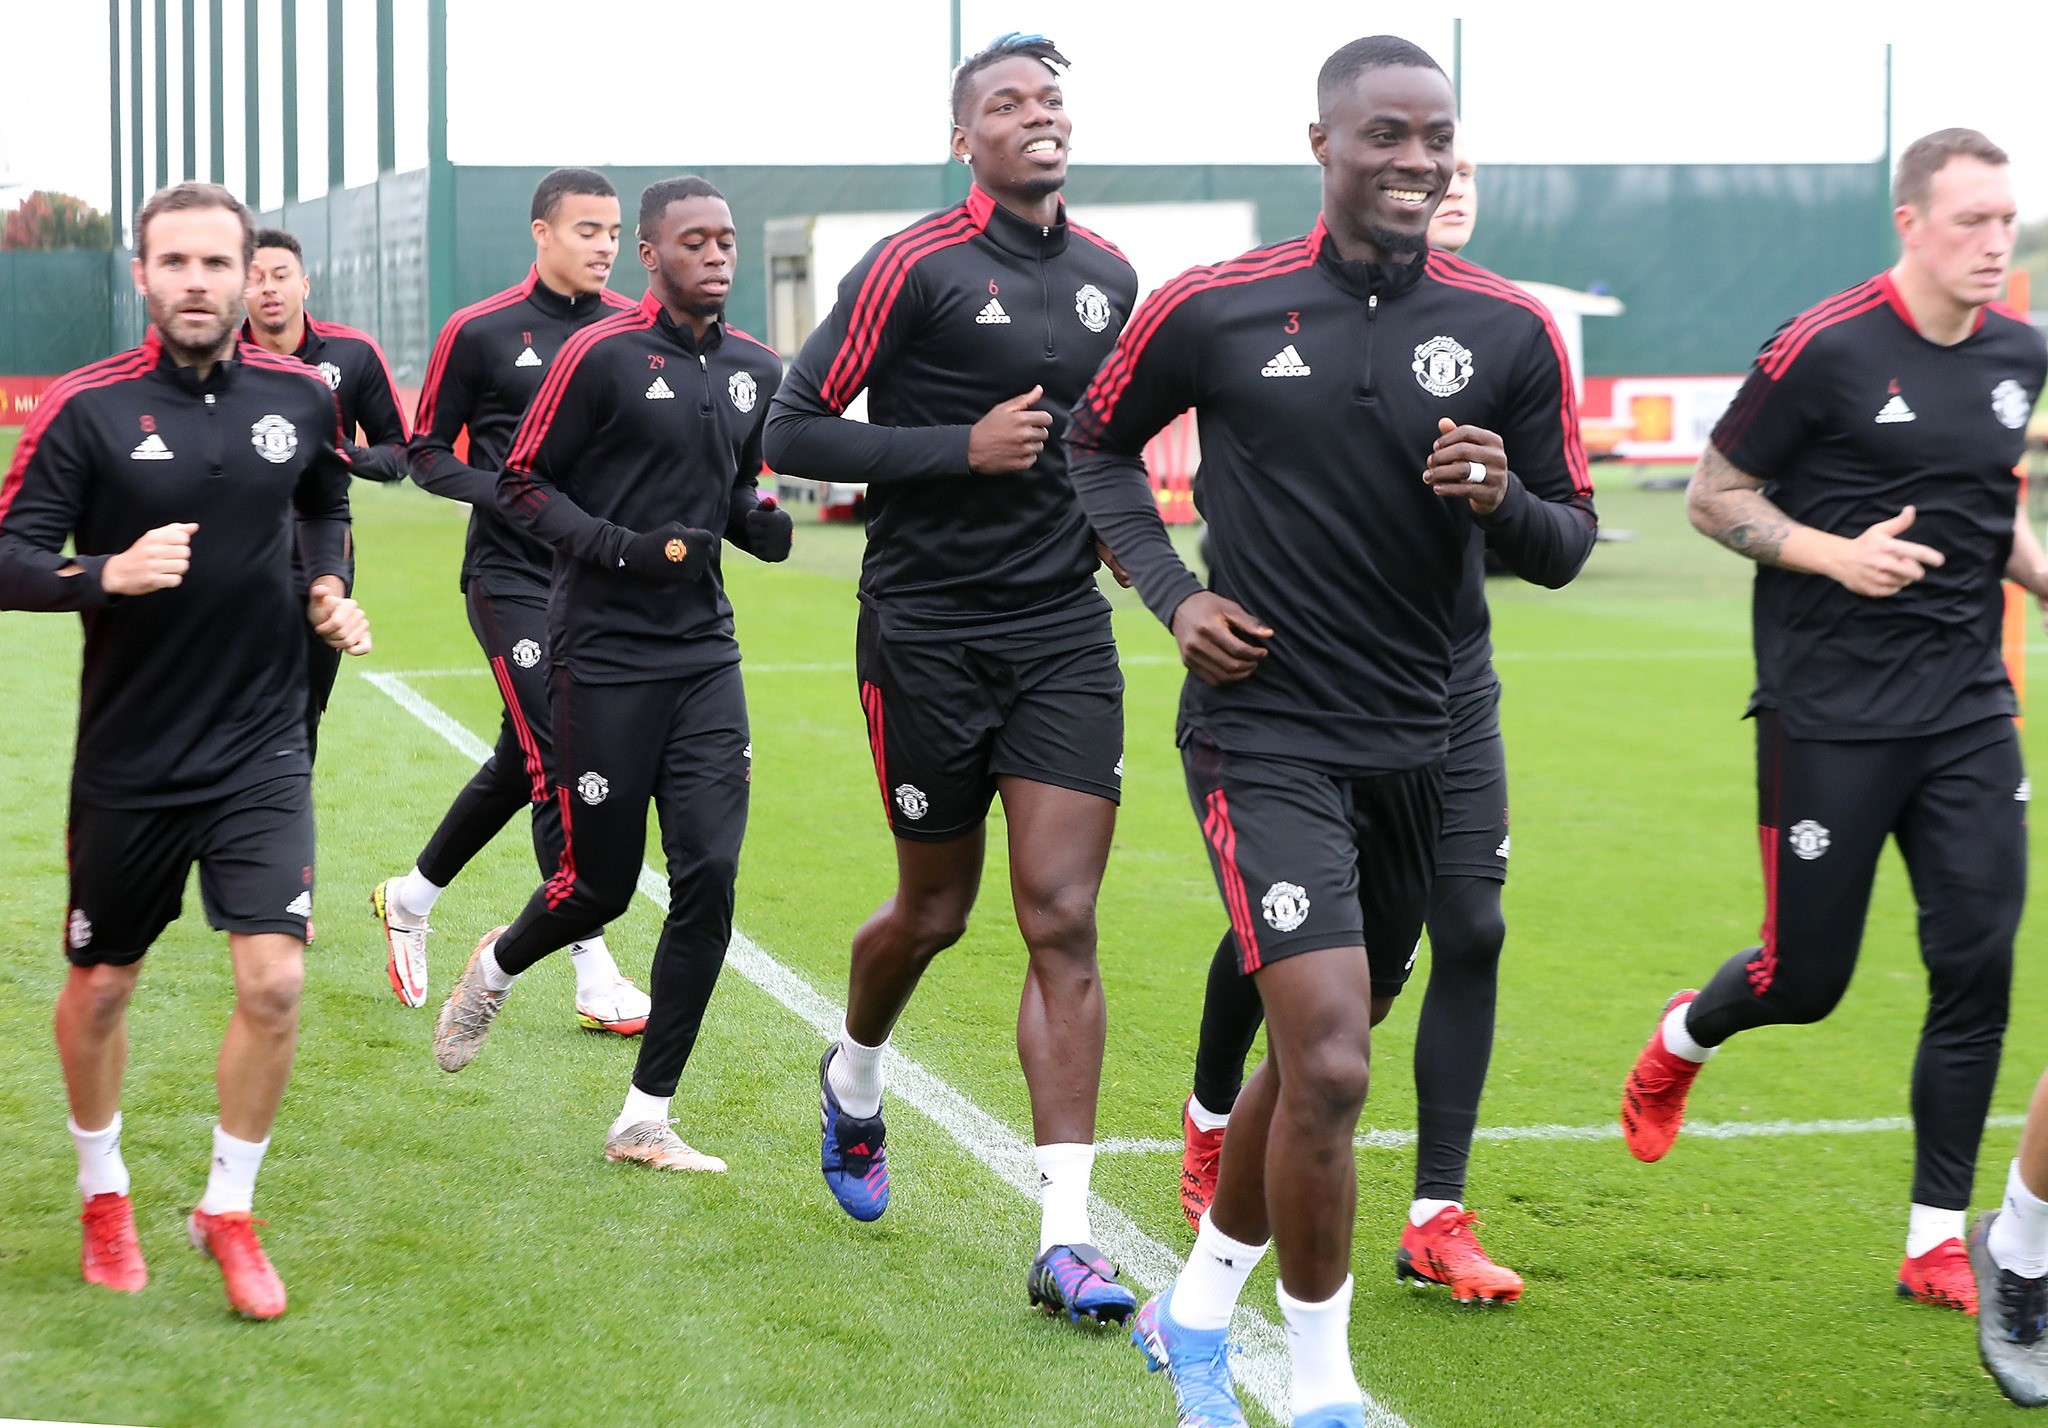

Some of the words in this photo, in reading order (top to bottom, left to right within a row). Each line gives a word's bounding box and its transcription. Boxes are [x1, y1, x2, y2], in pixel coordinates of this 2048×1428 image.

[989, 278, 999, 295] 6
[1284, 311, 1300, 334] 3
[647, 354, 665, 369] 29
[1261, 365, 1311, 377] adidas
